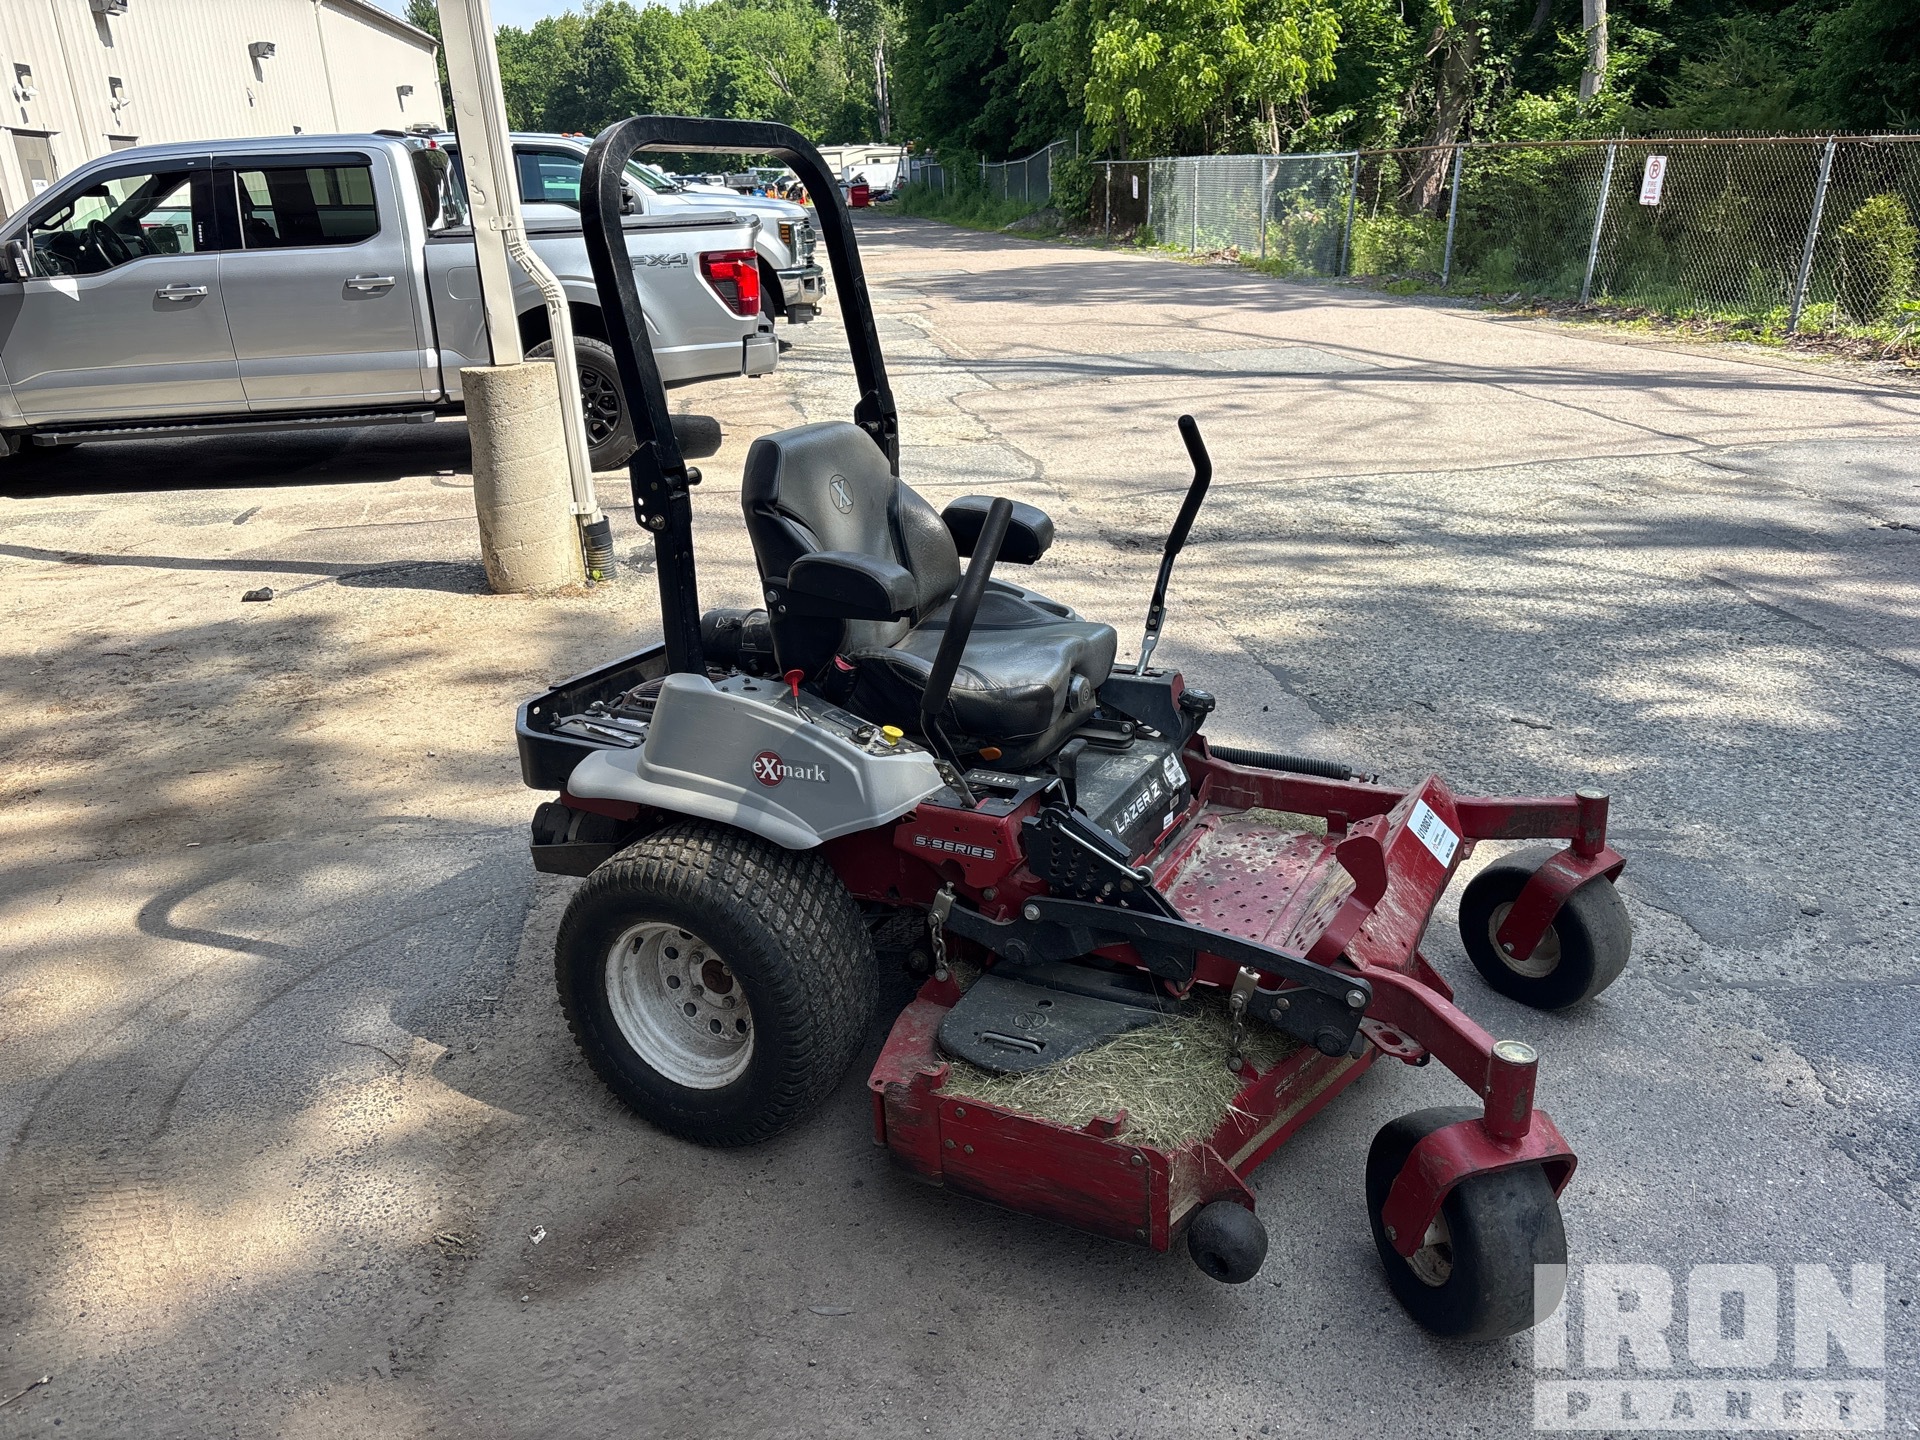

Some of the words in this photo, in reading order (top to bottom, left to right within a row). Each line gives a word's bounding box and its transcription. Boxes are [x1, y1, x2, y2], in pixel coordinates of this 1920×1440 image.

[629, 253, 688, 270] FX4
[753, 757, 826, 781] eXmark
[1115, 790, 1152, 833] LAZER
[1150, 782, 1161, 799] Z
[915, 836, 995, 859] S-SERIES
